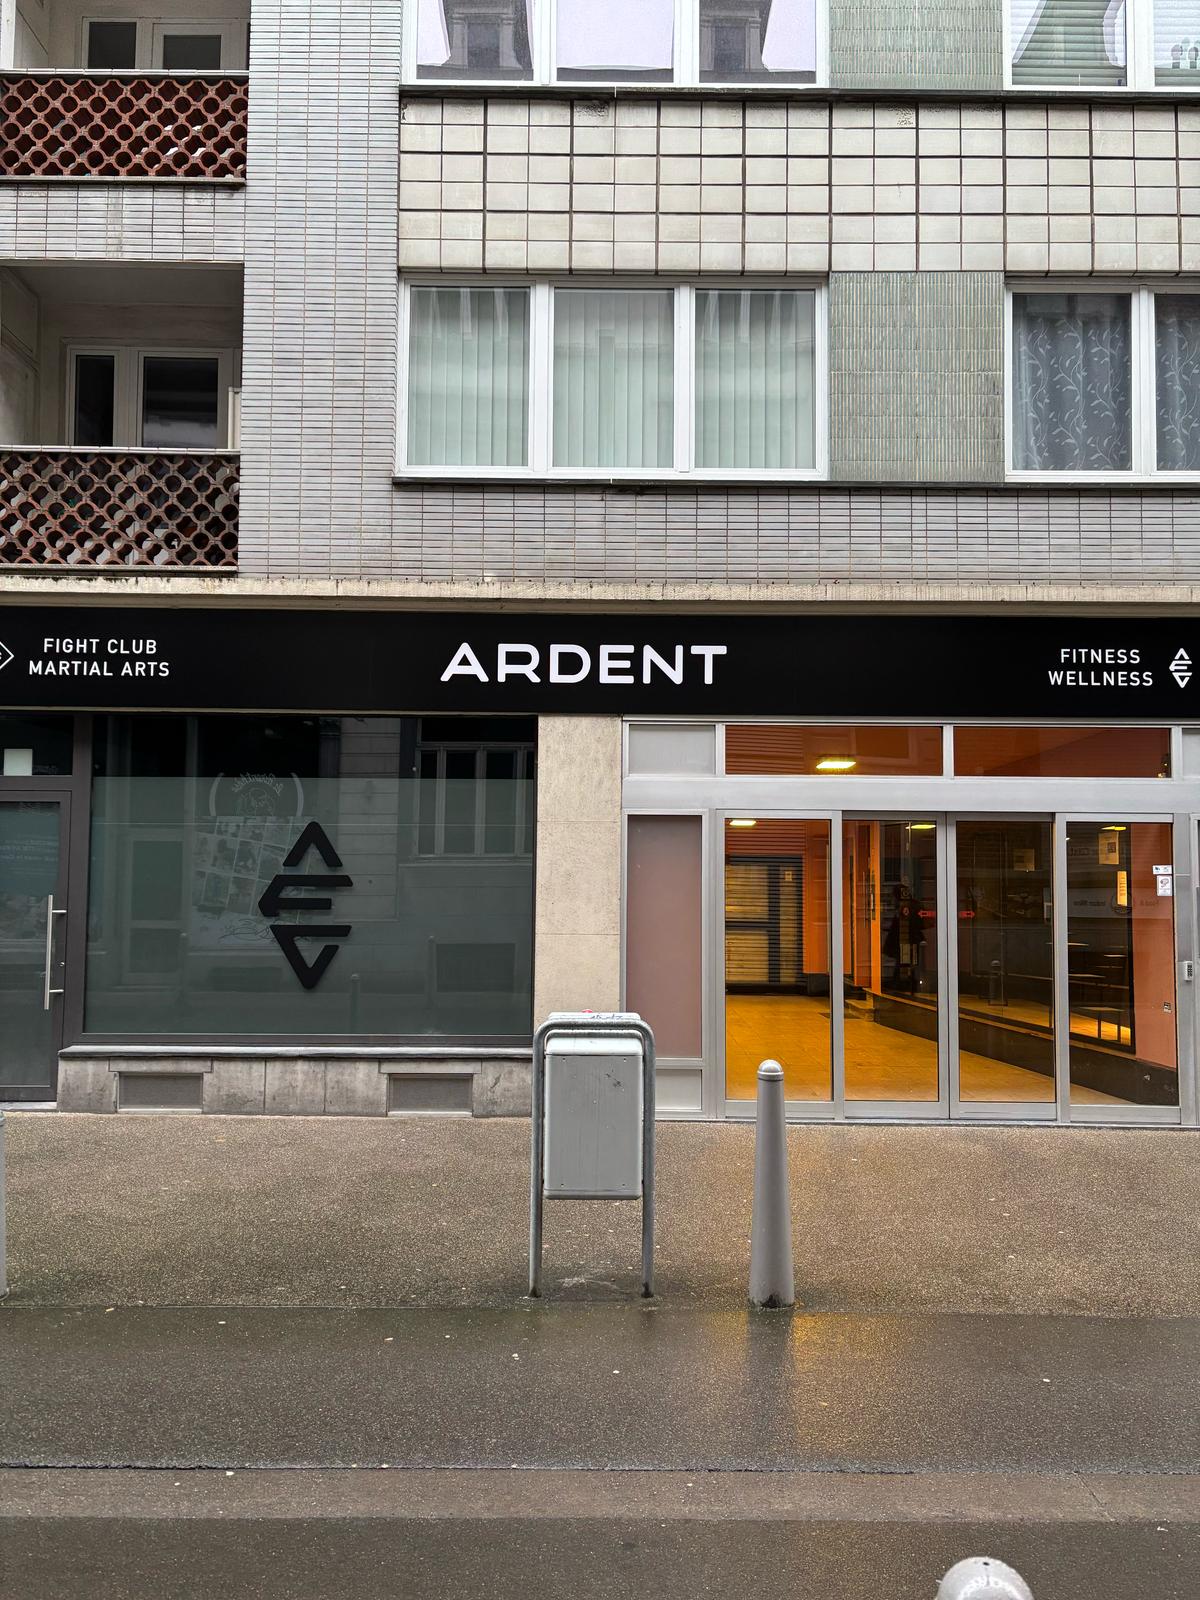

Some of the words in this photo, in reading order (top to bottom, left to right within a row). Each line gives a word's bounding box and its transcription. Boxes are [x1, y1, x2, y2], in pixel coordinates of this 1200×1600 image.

[43, 637, 99, 654] FIGHT
[107, 638, 157, 655] CLUB
[440, 642, 728, 685] ARDENT
[1060, 648, 1141, 664] FITNESS
[28, 660, 114, 677] MARTIAL
[120, 661, 170, 677] ARTS
[1047, 670, 1153, 687] WELLNESS
